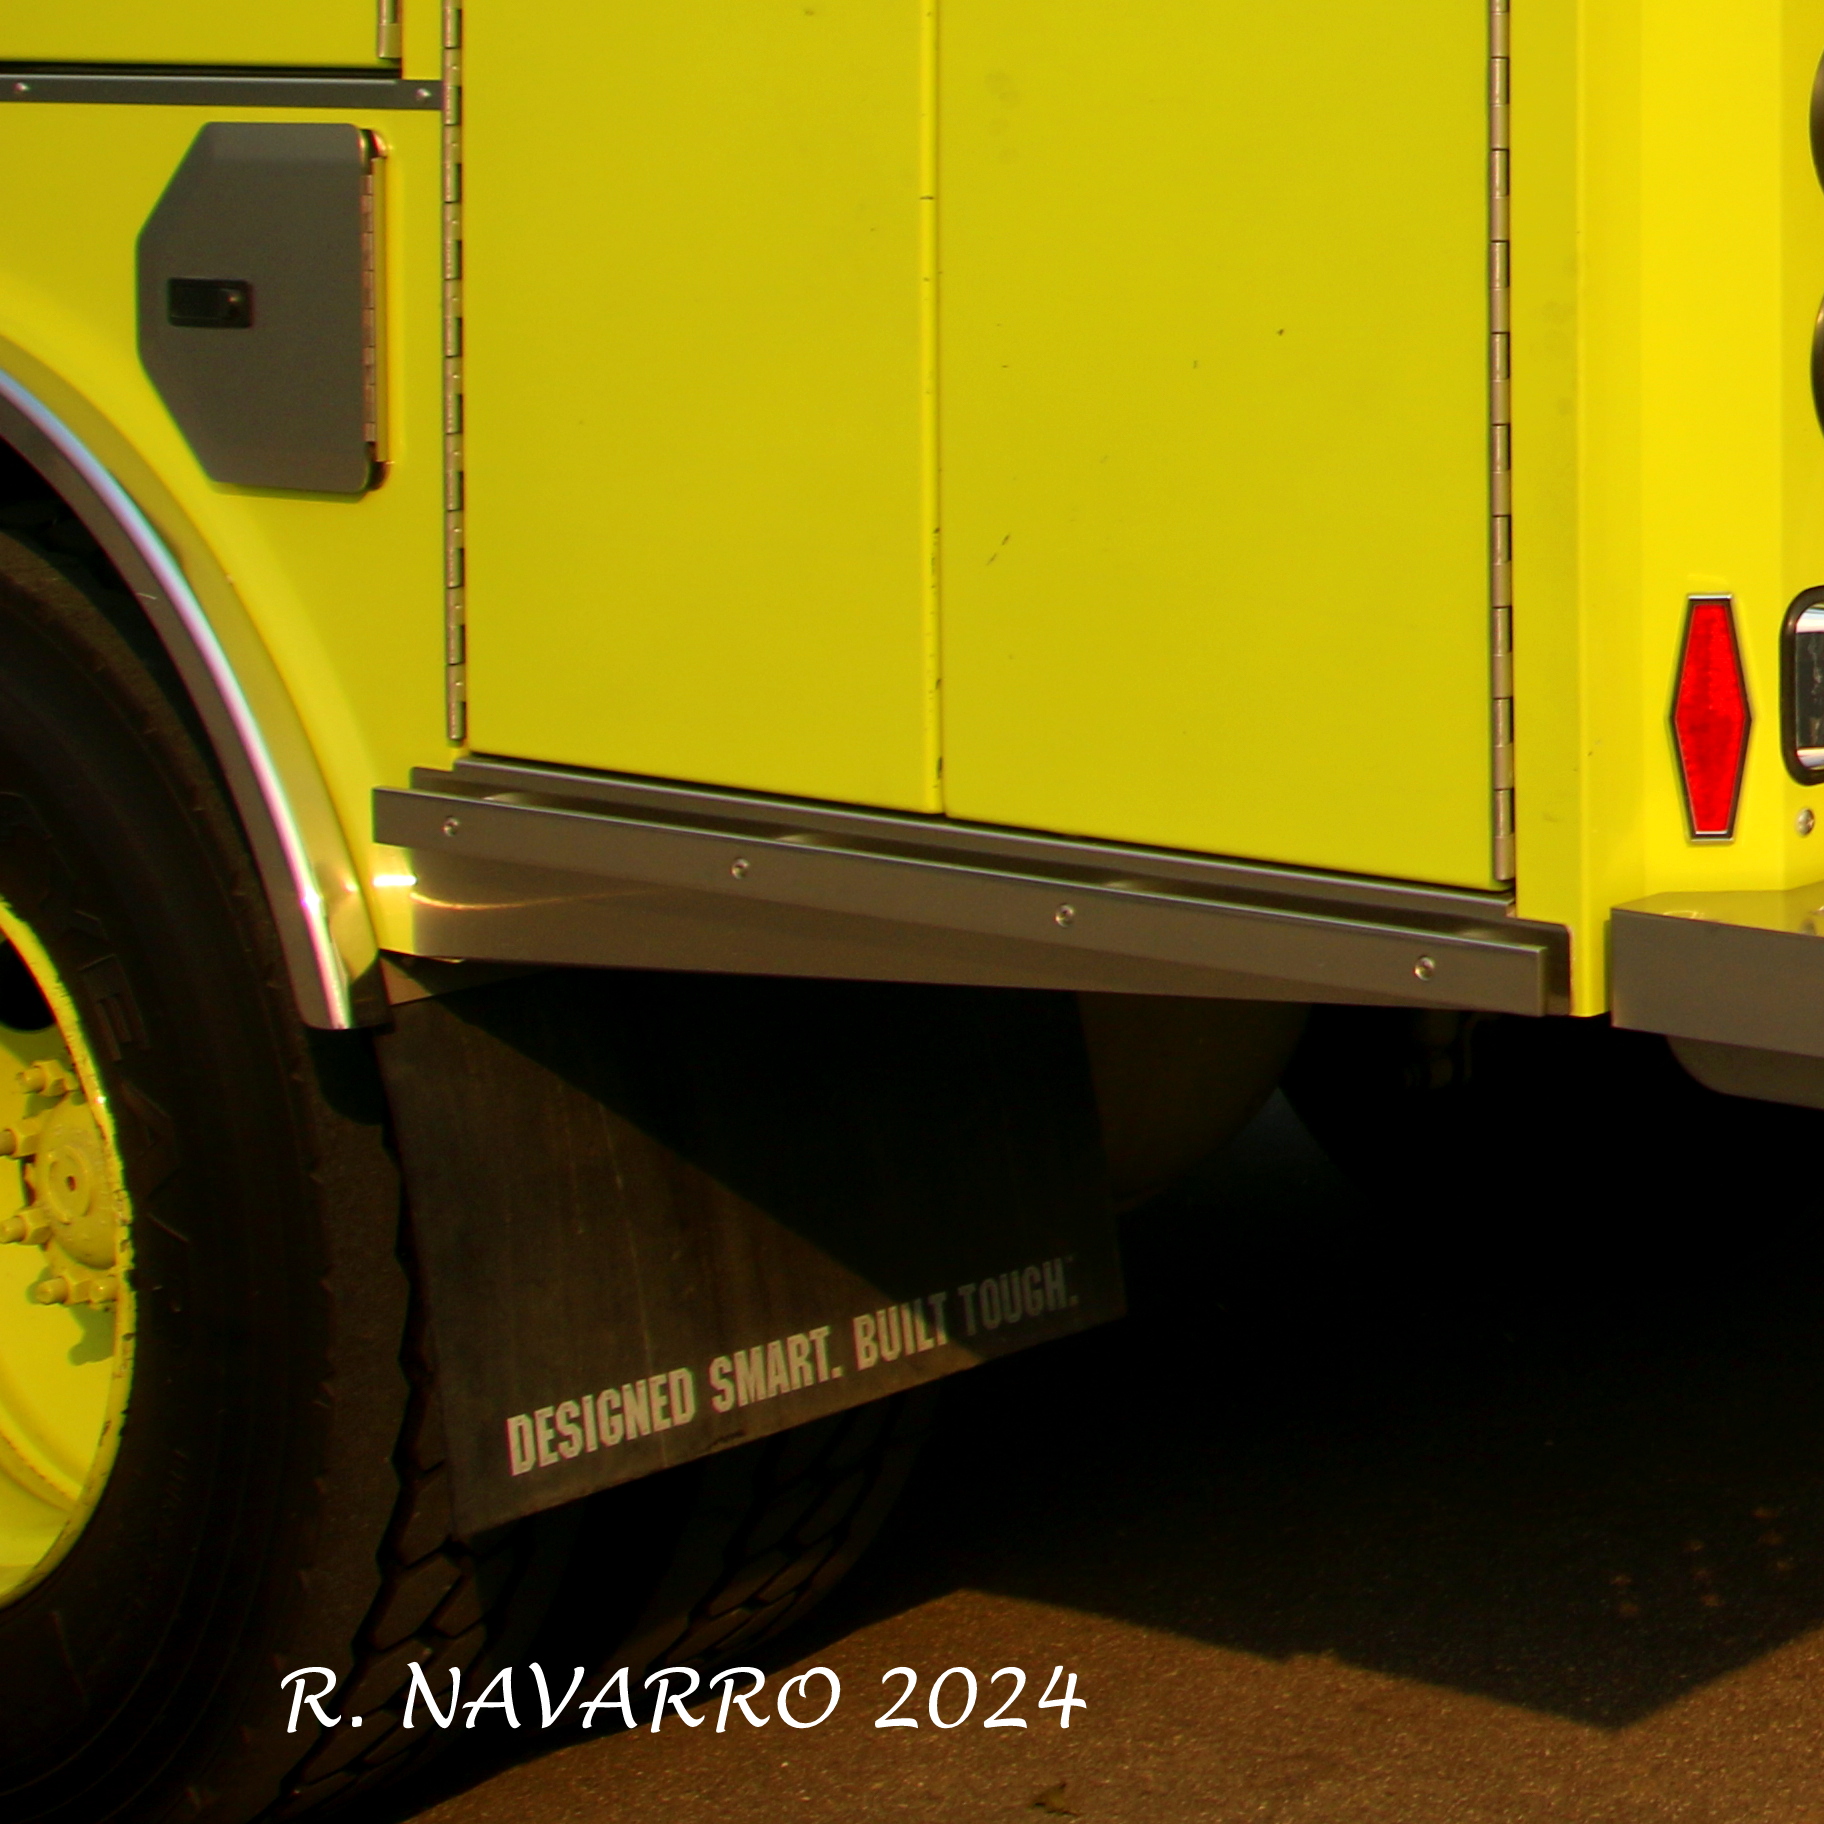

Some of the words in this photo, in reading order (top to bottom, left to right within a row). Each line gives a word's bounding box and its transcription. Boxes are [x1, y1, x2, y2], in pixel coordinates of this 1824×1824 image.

[506, 1366, 696, 1477] DESIGNED
[708, 1325, 844, 1414] SMART.
[852, 1290, 951, 1372] BUILT
